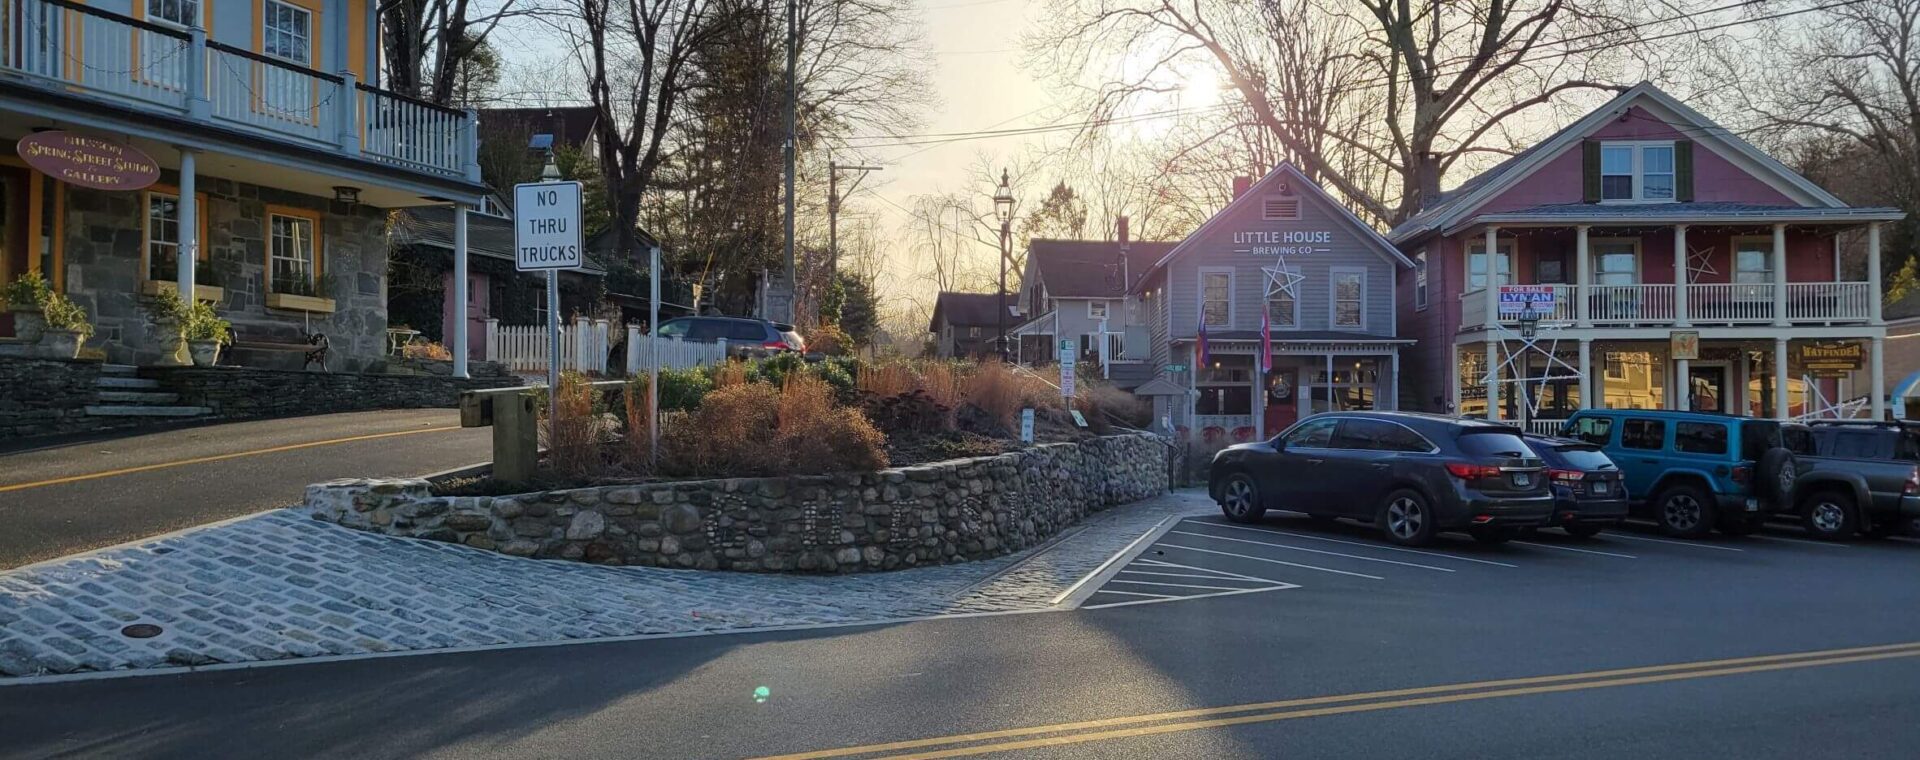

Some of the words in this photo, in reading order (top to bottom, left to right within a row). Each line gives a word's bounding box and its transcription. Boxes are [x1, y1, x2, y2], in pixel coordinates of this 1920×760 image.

[72, 149, 113, 166] STREET
[63, 168, 121, 184] GALLERY
[537, 190, 558, 207] NO
[529, 217, 567, 235] THRU
[1233, 231, 1280, 244] LITTLE
[1283, 231, 1331, 243] HOUSE
[521, 245, 576, 263] TRUCKS
[1252, 246, 1296, 255] BREWING
[1298, 246, 1312, 254] CO
[1503, 293, 1551, 301] LYMAN
[1802, 345, 1860, 357] WAYFINDER
